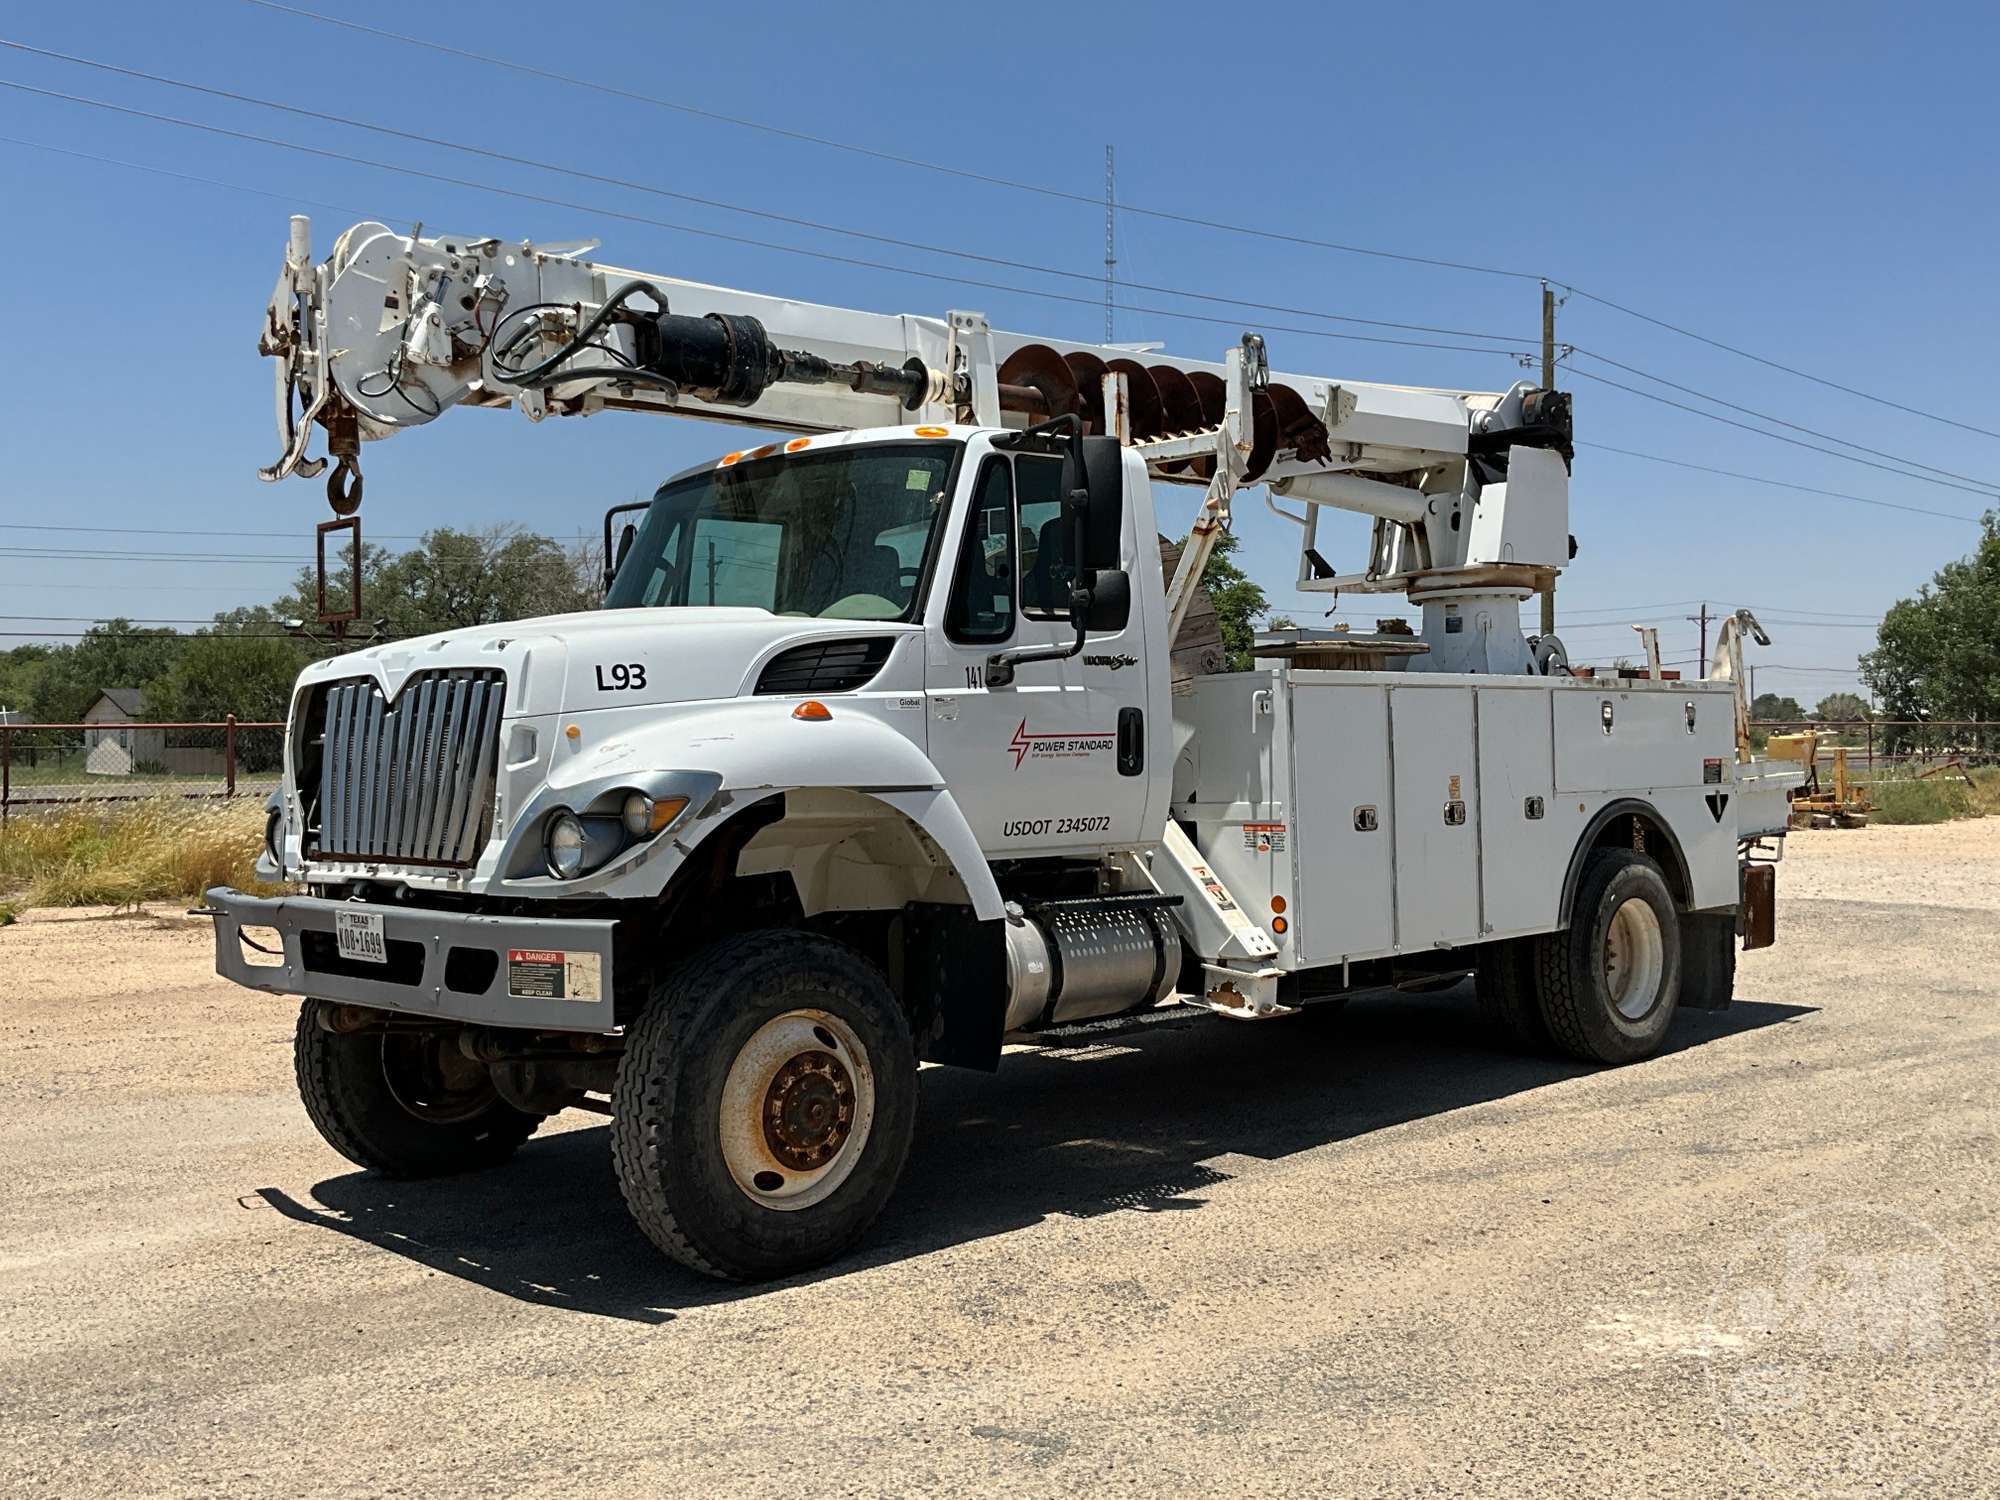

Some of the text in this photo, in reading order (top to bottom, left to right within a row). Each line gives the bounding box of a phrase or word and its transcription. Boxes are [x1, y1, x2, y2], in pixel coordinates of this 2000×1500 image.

[595, 663, 647, 691] L93
[965, 666, 982, 689] 141
[899, 698, 921, 706] Global
[1032, 740, 1113, 752] POWER STANDARD
[1003, 816, 1110, 837] USDOT 2345072
[350, 914, 369, 925] TEXAS
[525, 952, 557, 961] DANGER
